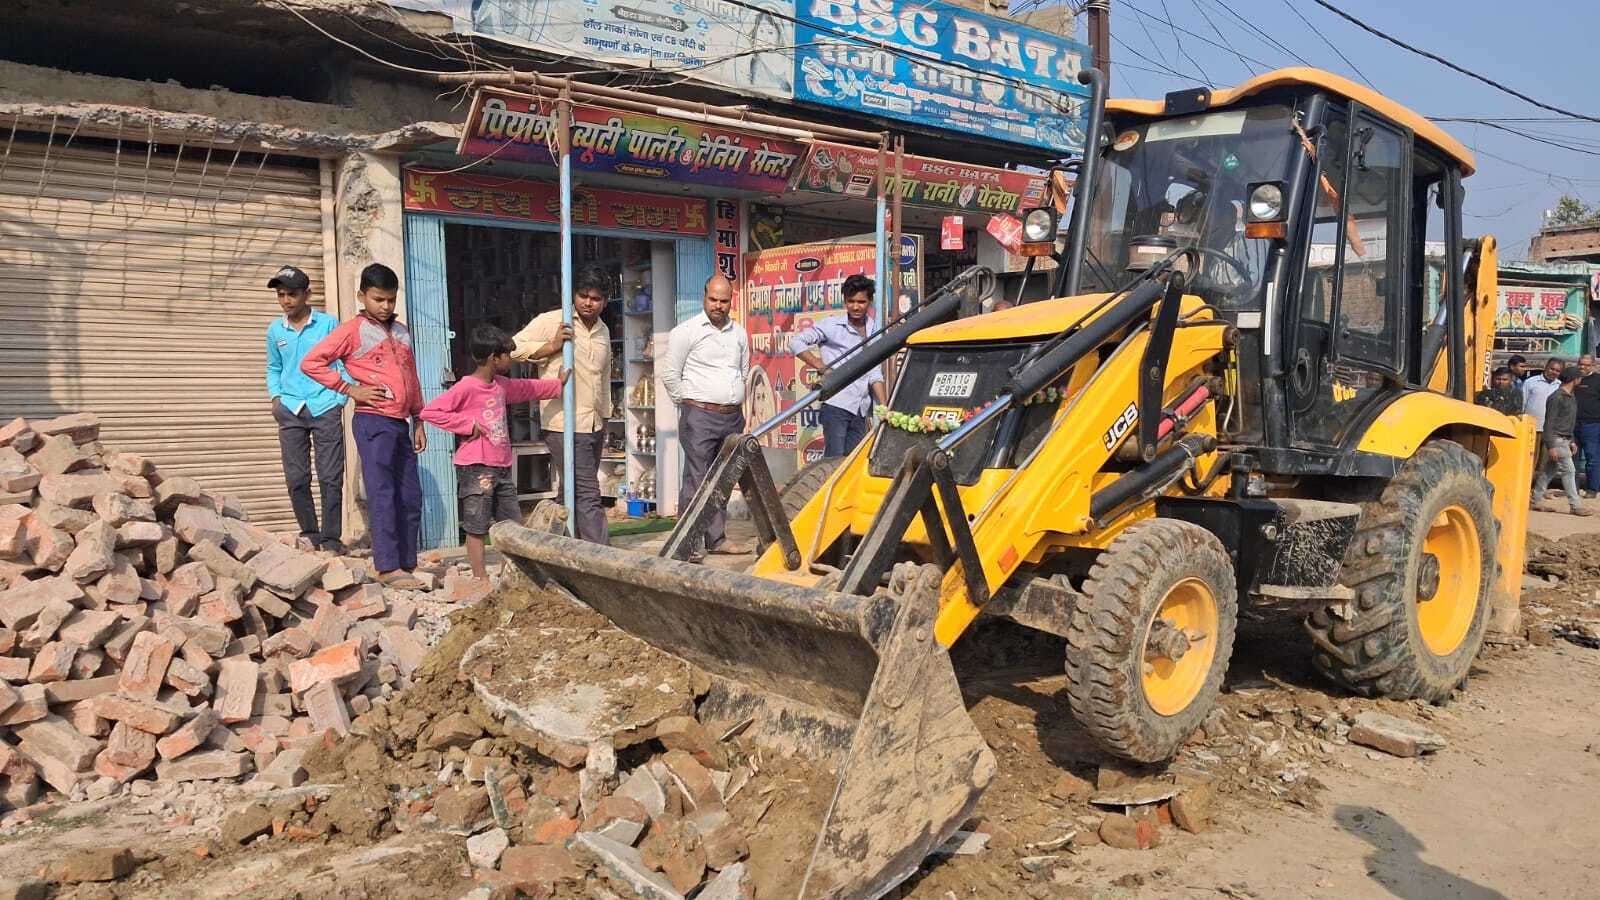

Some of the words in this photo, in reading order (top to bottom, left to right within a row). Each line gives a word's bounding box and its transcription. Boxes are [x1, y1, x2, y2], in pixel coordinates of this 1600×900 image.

[952, 16, 1088, 88] BATA
[921, 163, 956, 176] BSG
[959, 168, 1000, 183] BATA
[1106, 403, 1139, 449] JCB
